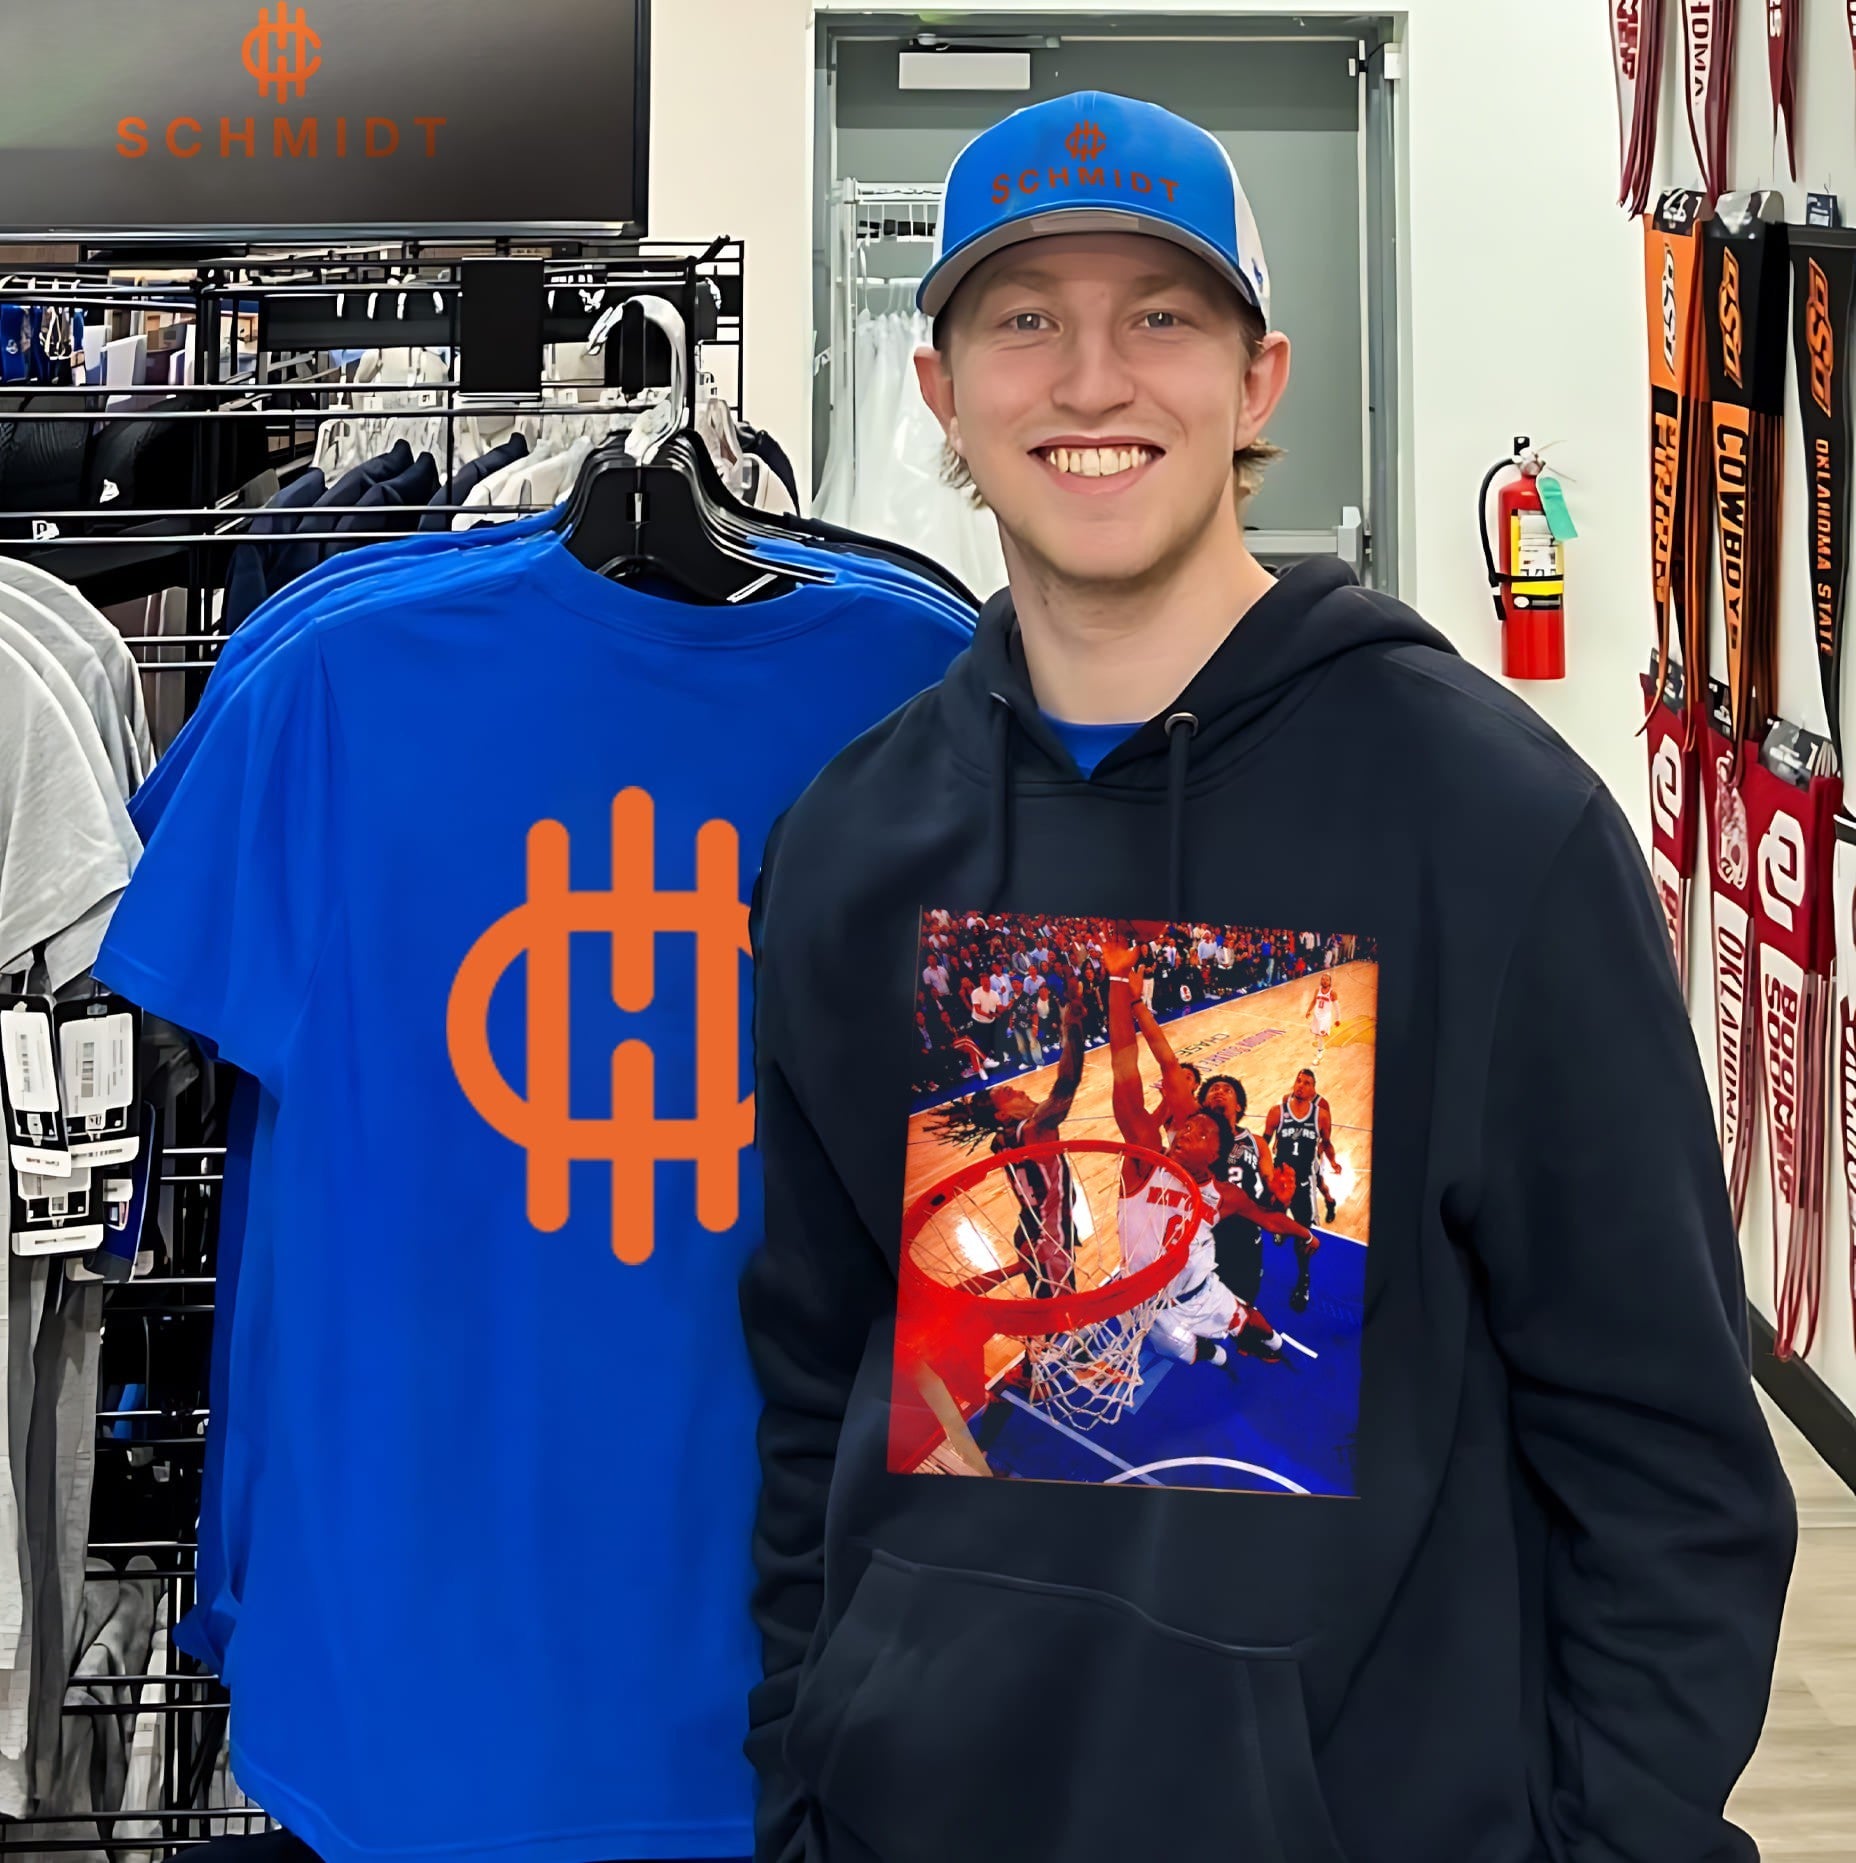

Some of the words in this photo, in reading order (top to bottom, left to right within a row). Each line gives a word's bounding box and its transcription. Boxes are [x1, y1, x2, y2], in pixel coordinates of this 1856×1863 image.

[116, 116, 448, 159] SCHMIDT
[991, 166, 1179, 205] SCHMIDT
[1815, 439, 1832, 570] OKLAHOMA
[1292, 1141, 1299, 1156] 1
